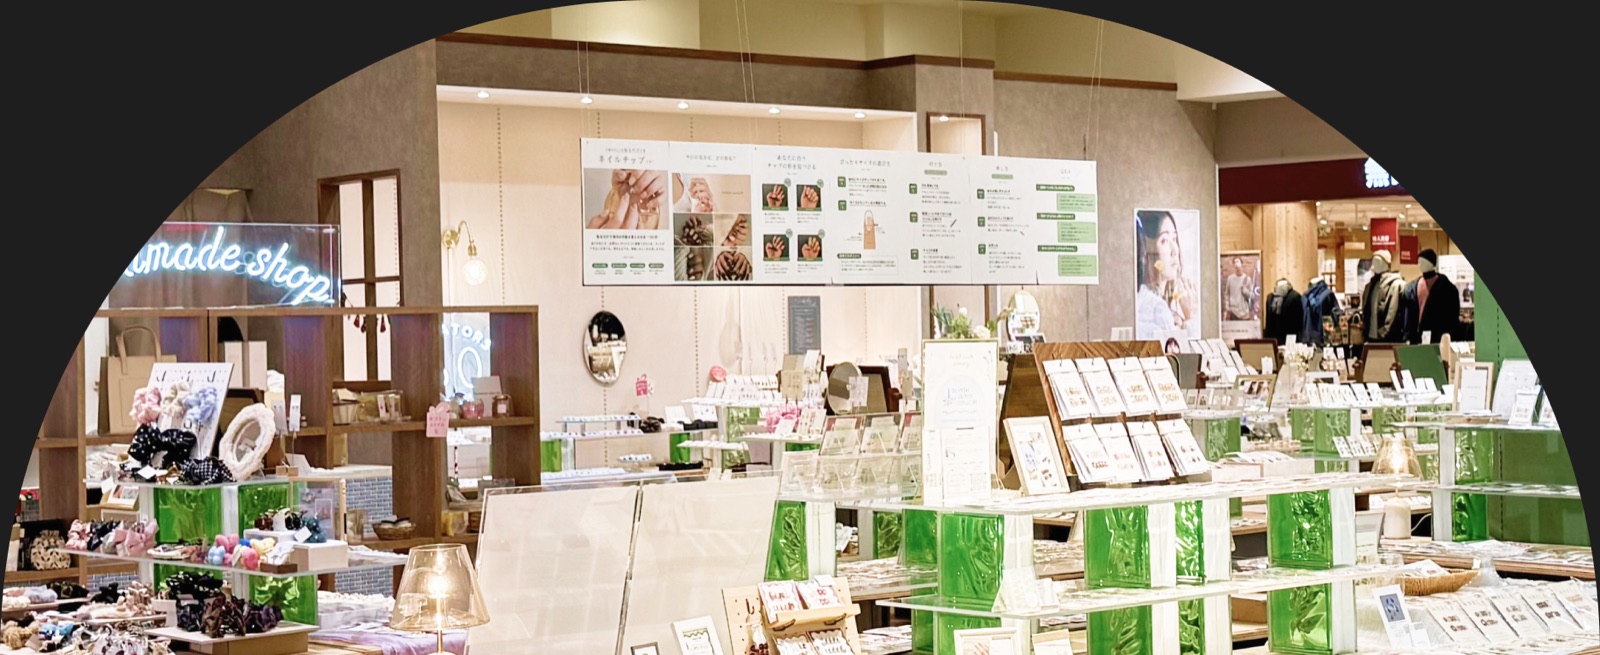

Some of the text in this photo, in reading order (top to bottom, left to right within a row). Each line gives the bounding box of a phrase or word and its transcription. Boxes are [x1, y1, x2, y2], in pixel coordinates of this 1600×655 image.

[599, 154, 646, 164] ネイルチップ
